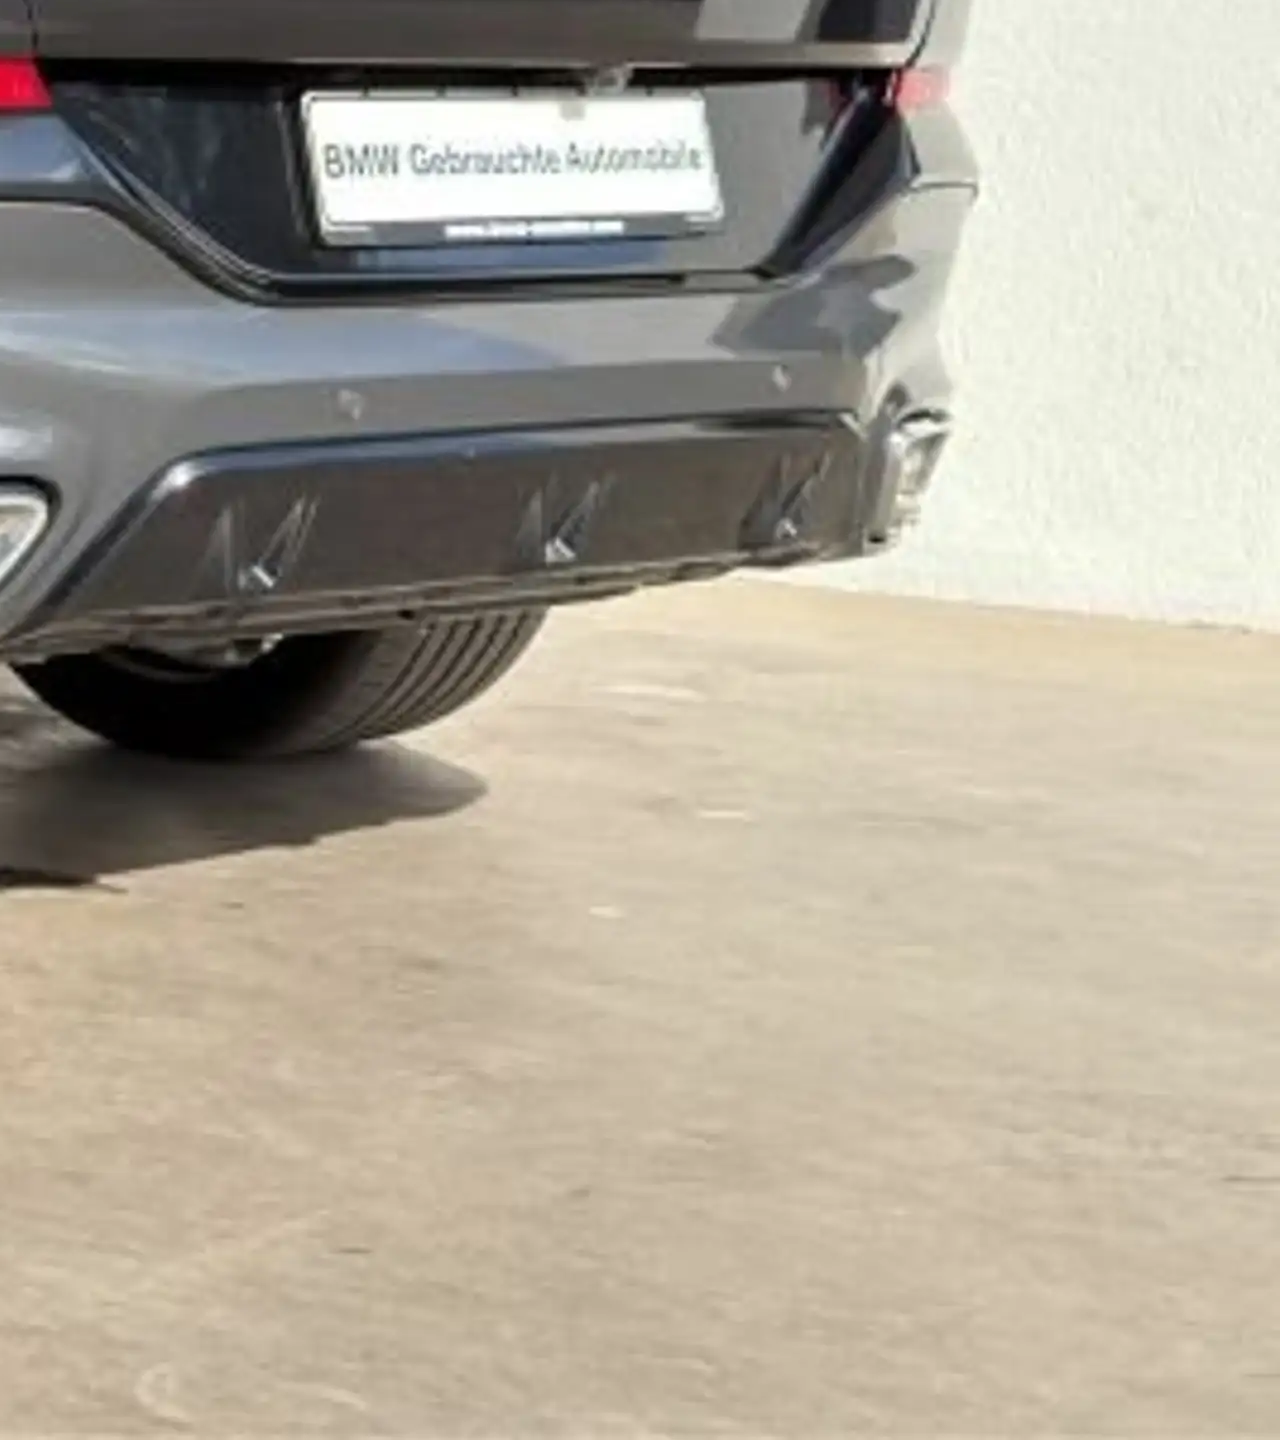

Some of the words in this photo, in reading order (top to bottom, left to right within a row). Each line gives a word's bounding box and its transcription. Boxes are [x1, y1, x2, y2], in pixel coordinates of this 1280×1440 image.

[325, 143, 401, 178] BMW
[410, 142, 562, 176] Gebrauchte
[566, 140, 704, 173] Automobile
